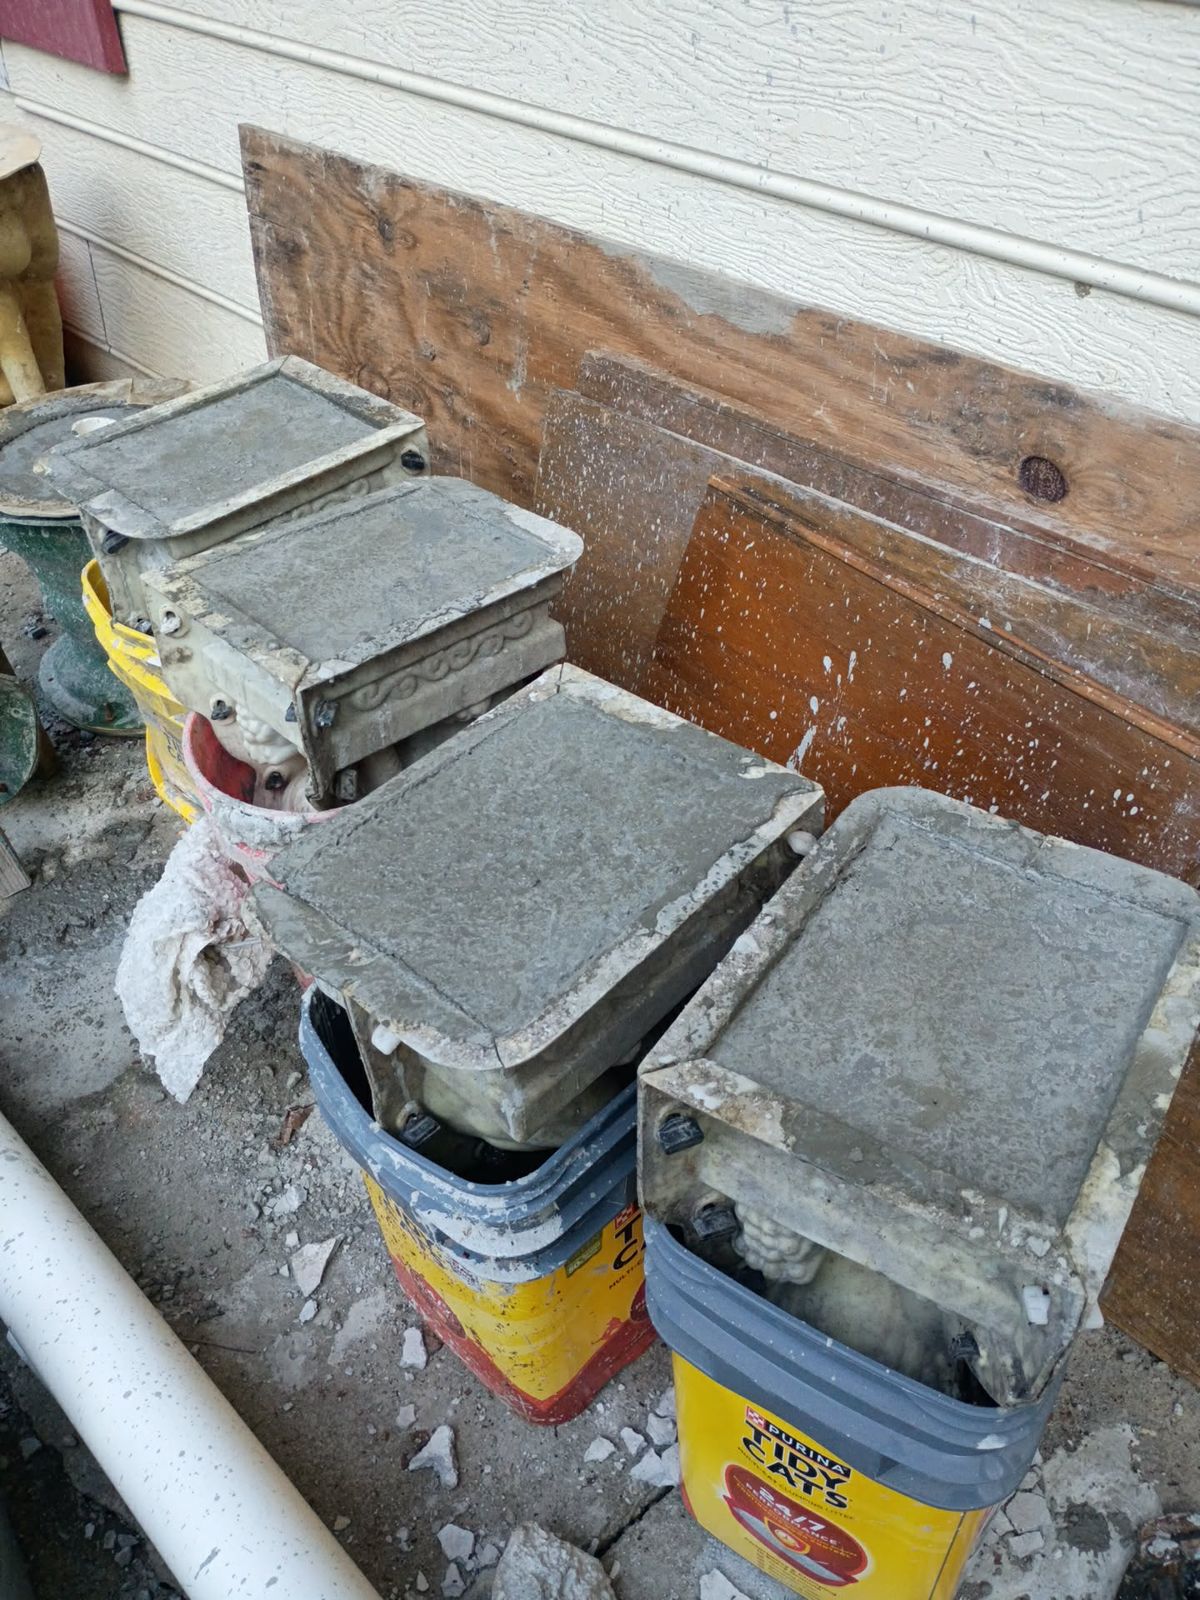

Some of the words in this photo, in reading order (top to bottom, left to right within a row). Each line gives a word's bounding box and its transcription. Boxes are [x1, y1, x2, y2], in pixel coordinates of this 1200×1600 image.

[742, 1437, 848, 1509] CATS
[745, 1419, 847, 1490] TIDY
[768, 1424, 846, 1475] PURINA
[746, 1482, 838, 1545] PERFORMANCE
[759, 1486, 826, 1532] 24/7
